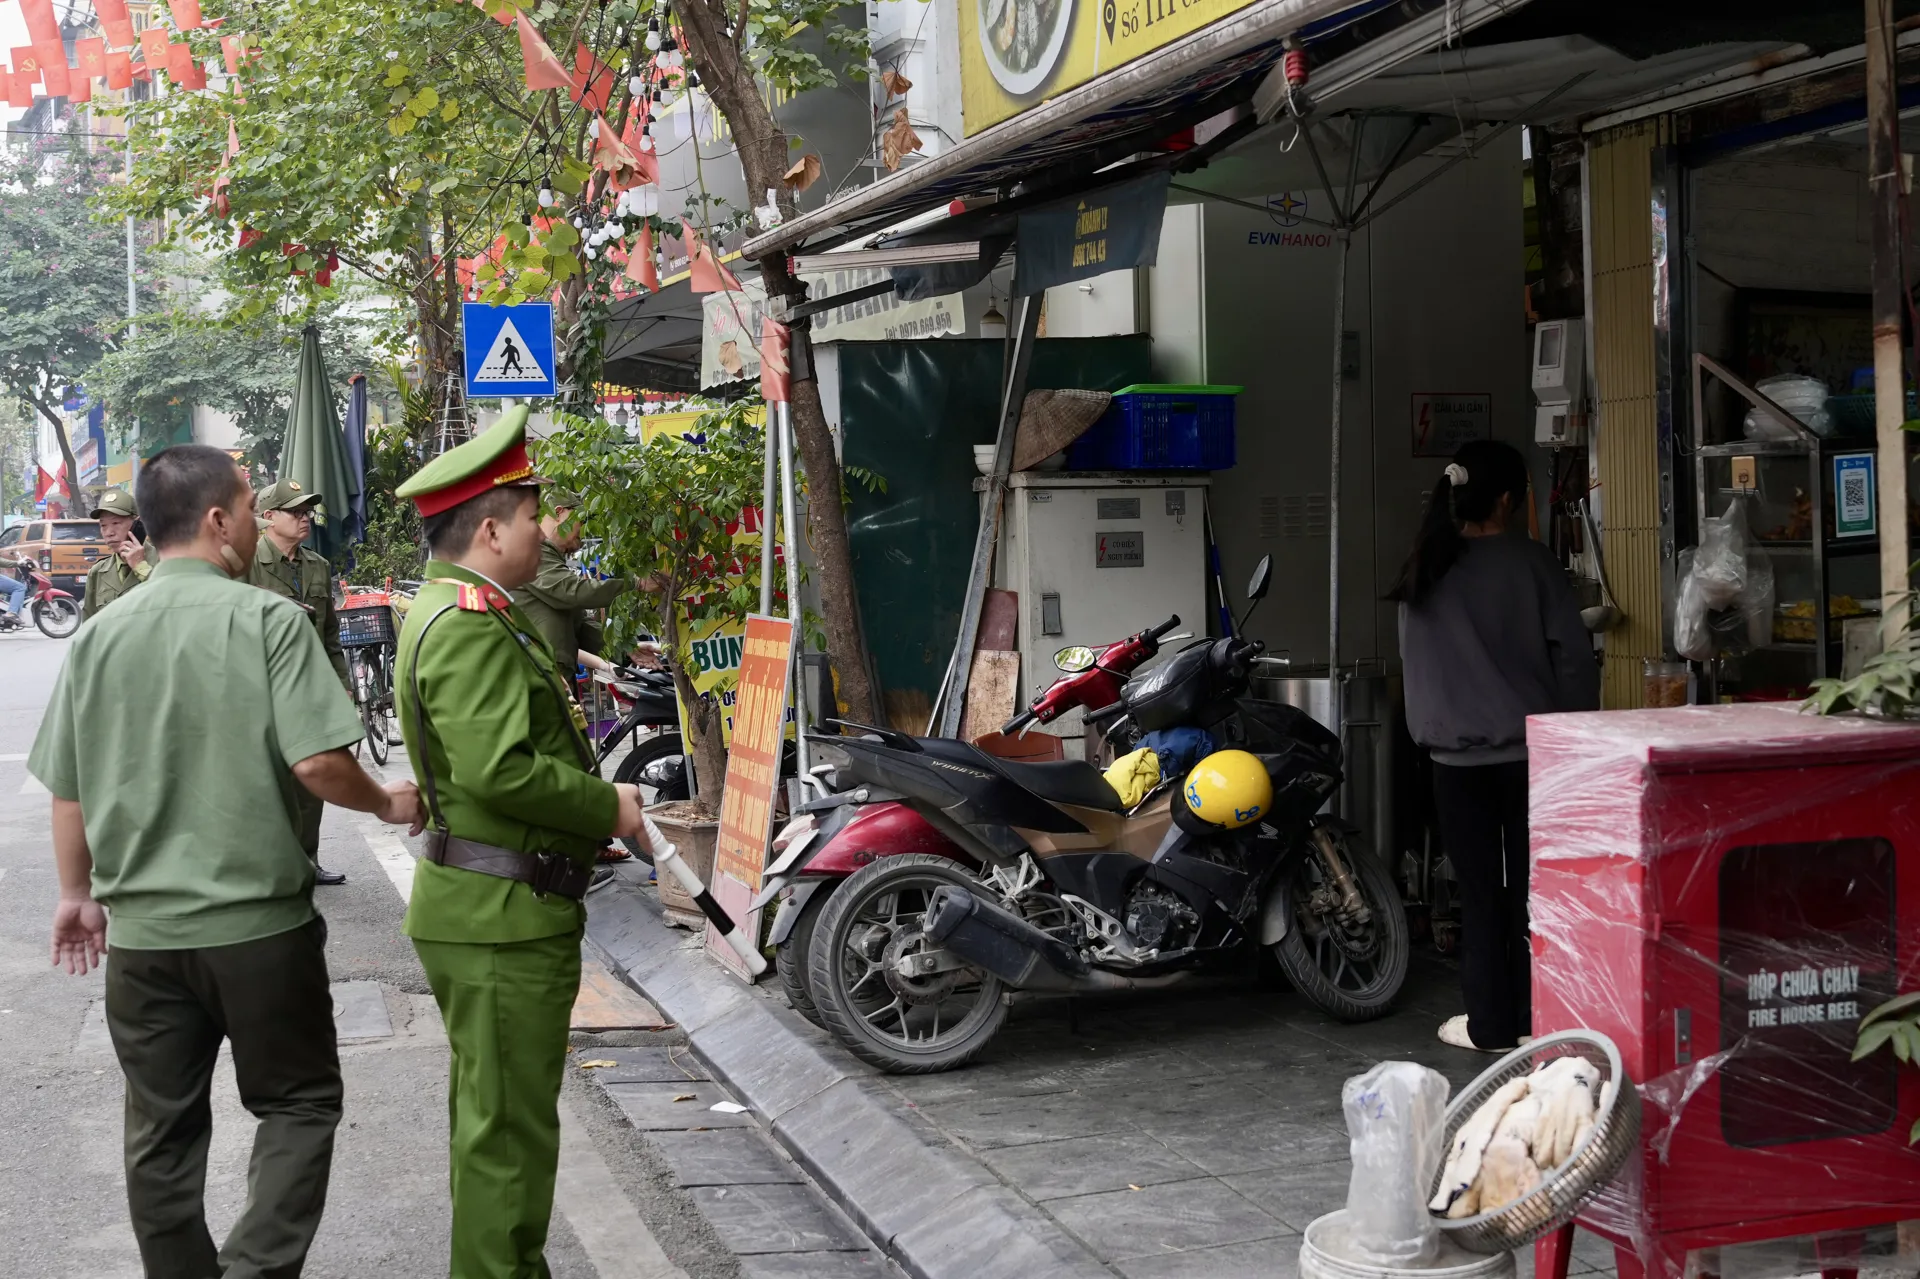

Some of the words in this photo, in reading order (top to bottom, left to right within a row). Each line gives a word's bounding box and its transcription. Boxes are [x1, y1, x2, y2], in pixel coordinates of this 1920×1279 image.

[1121, 2, 1139, 38] Số
[1248, 232, 1331, 248] EVNHANOI
[899, 312, 952, 339] 0978.669.958
[692, 631, 744, 672] BÚN
[1186, 779, 1203, 809] be
[1235, 806, 1260, 822] be
[1748, 967, 1778, 1006] HỘP
[1781, 964, 1819, 998] CHỮA
[1748, 1008, 1778, 1028] FIRE
[1781, 1004, 1825, 1025] HOUSE
[1827, 1001, 1860, 1021] REEL
